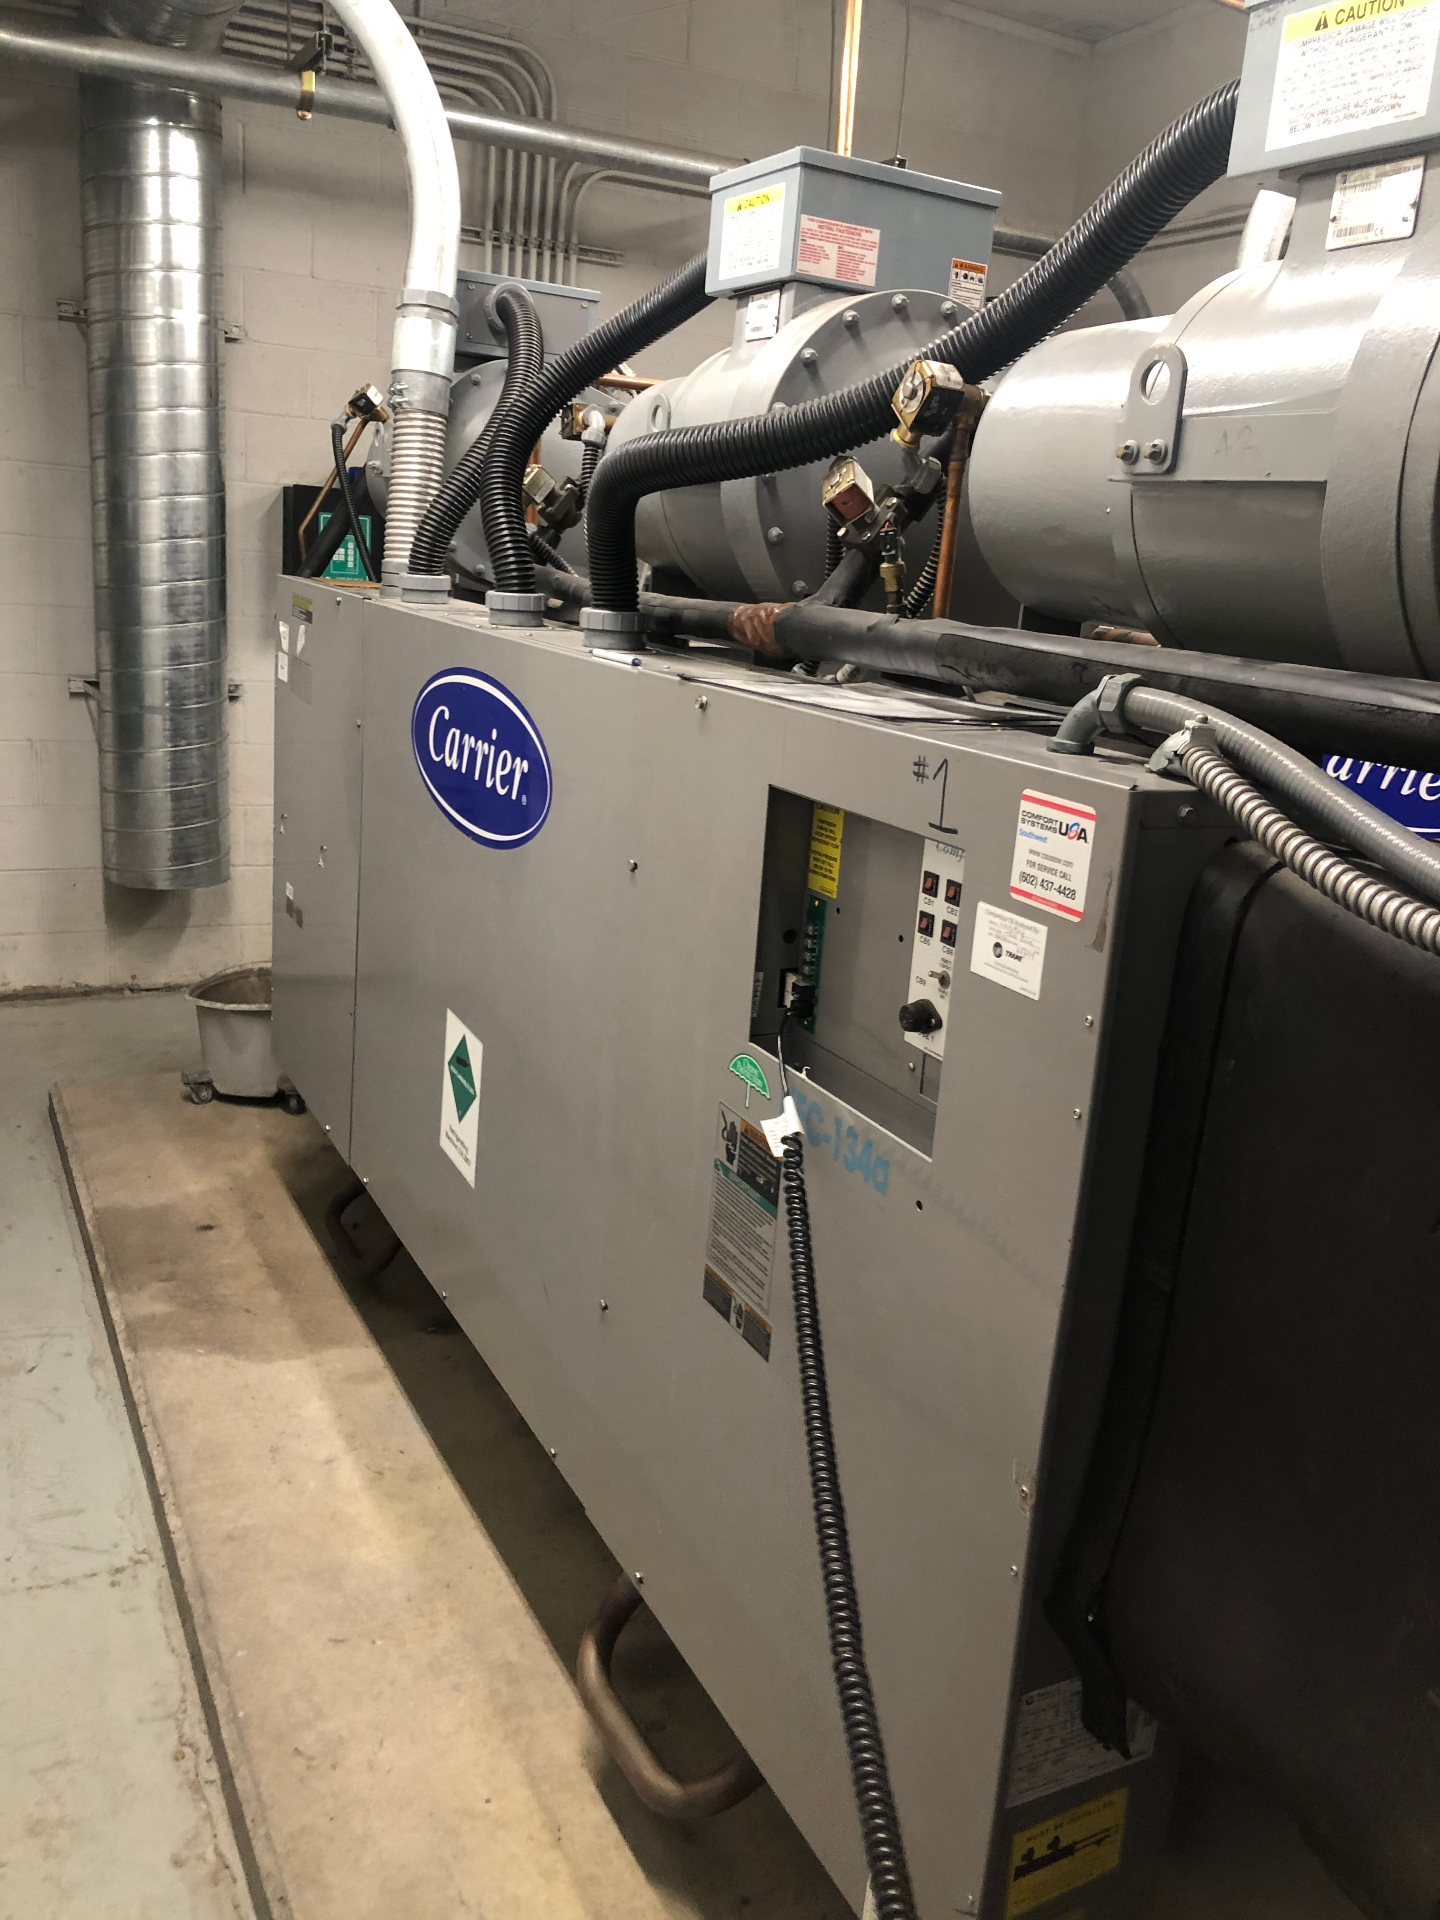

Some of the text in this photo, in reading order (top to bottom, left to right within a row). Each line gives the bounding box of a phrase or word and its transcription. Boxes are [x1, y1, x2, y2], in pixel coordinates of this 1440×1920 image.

[1334, 0, 1405, 26] CAUTION
[428, 705, 529, 801] Carrier
[1021, 810, 1059, 826] COMFORT
[1018, 828, 1048, 844] Southwest
[1020, 817, 1088, 843] SYSTEMS USA
[1026, 859, 1072, 882] FOR SERVICE CALL
[1019, 870, 1077, 901] (602) 437-4428
[923, 896, 935, 908] CB1
[946, 905, 958, 917] CB2
[1005, 949, 1023, 962] TRANE
